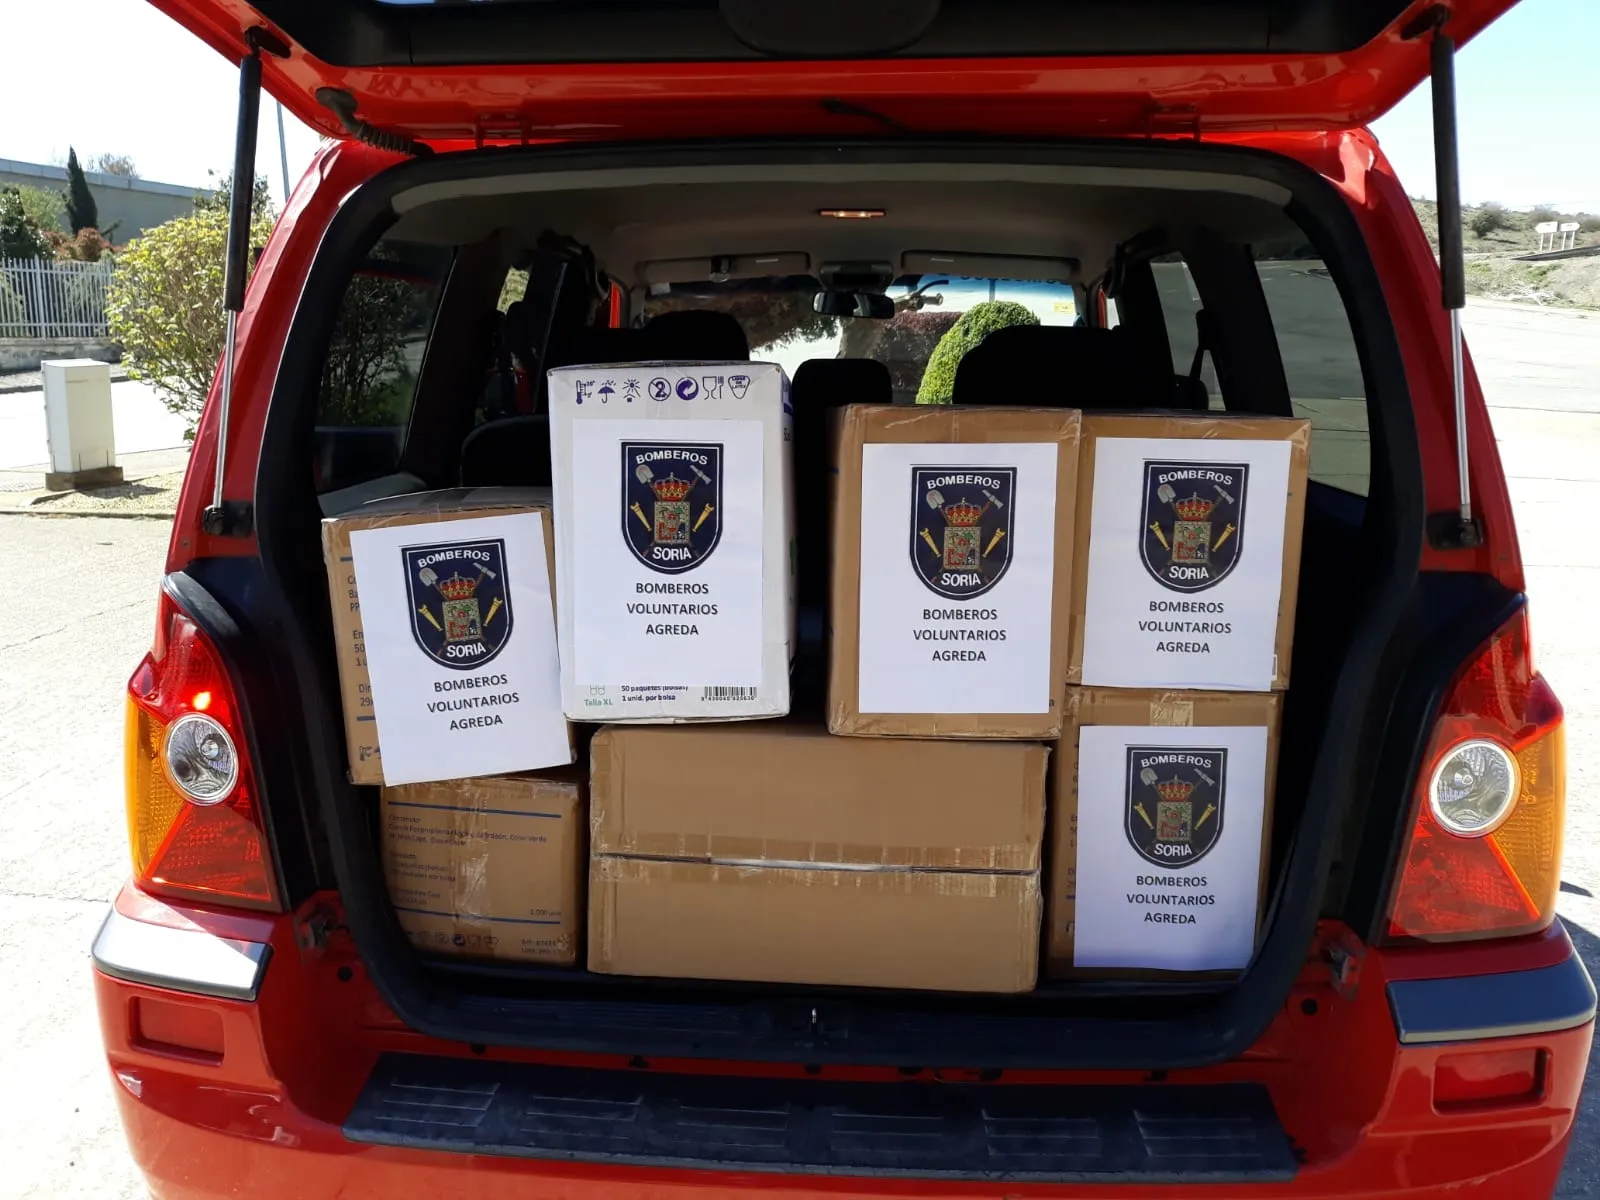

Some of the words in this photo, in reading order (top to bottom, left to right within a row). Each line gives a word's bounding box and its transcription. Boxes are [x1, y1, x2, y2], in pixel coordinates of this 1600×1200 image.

[635, 450, 709, 465] BOMBEROS
[926, 474, 1001, 490] BOMBEROS
[1158, 469, 1233, 485] BOMBEROS
[417, 549, 491, 568] BOMBEROS
[652, 546, 692, 561] SORIA
[940, 572, 982, 587] SORIA
[1168, 565, 1210, 580] SORIA
[635, 582, 709, 595] BOMBEROS
[626, 602, 719, 616] VOLUNTARIOS
[1149, 600, 1225, 614] BOMBEROS
[922, 608, 998, 621] BOMBEROS
[645, 623, 700, 636] AGREDA
[1138, 620, 1232, 634] VOLUNTARIOS
[912, 629, 1007, 642] VOLUNTARIOS
[446, 642, 487, 659] SORIA
[1155, 641, 1211, 654] AGREDA
[931, 650, 988, 662] AGREDA
[433, 673, 508, 693] BOMBEROS
[360, 697, 374, 707] 29
[426, 692, 520, 713] VOLUNTARIOS
[584, 698, 602, 707] Talla
[603, 697, 613, 706] XL
[645, 695, 657, 703] por
[657, 693, 676, 701] bolsa
[449, 714, 504, 731] AGREDA
[1140, 754, 1213, 769] BOMBEROS
[1153, 843, 1193, 857] SORIA
[1136, 875, 1208, 888] BOMBEROS
[1126, 893, 1216, 907] VOLUNTARIOS
[1143, 911, 1197, 925] AGREDA
